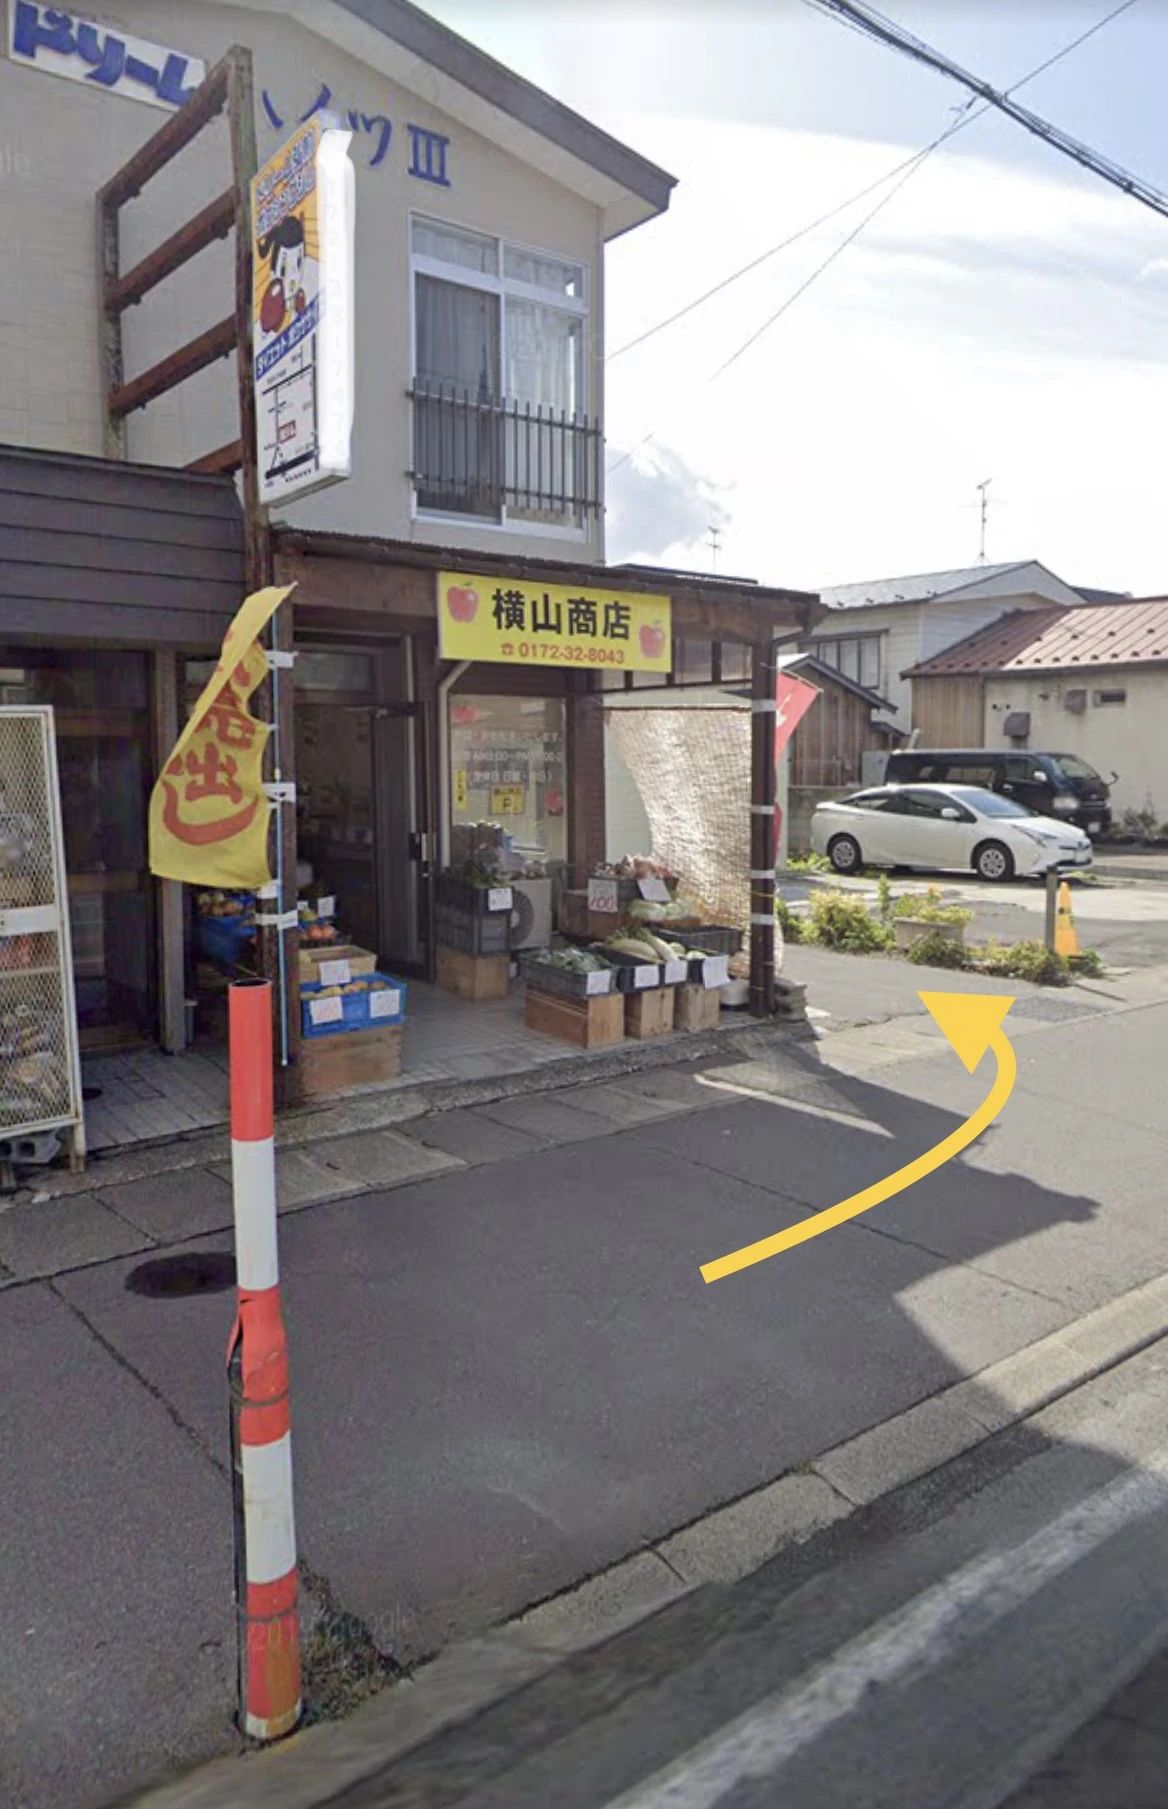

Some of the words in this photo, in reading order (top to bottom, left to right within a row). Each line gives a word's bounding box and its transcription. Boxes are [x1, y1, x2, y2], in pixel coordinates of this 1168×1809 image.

[491, 588, 632, 641] 横山商店
[518, 642, 625, 665] 0172-32-8043
